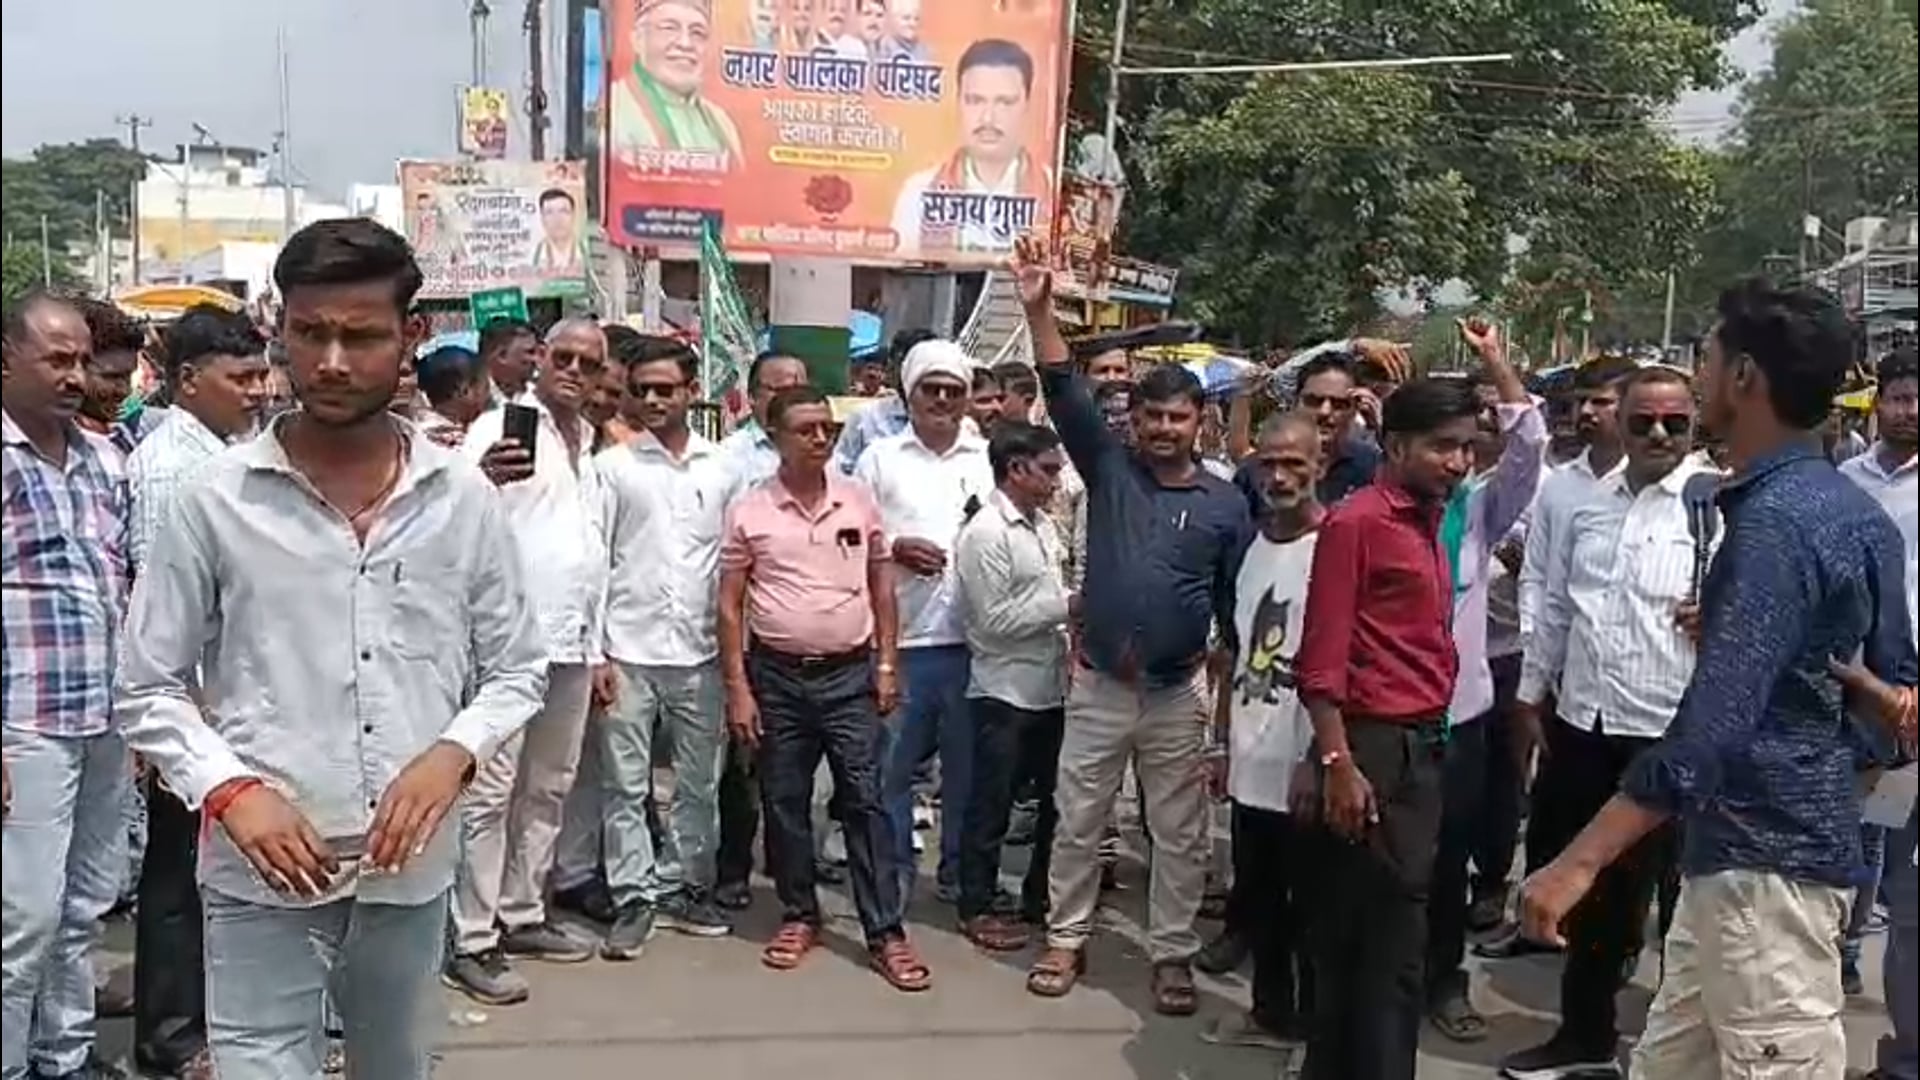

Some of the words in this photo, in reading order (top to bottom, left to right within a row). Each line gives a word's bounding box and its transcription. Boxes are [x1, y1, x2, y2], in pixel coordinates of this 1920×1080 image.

[723, 48, 778, 84] नगर
[786, 46, 868, 90] पालिका
[876, 53, 943, 95] परिषद
[921, 184, 989, 225] संजय
[991, 195, 1037, 237] गुप्ता
